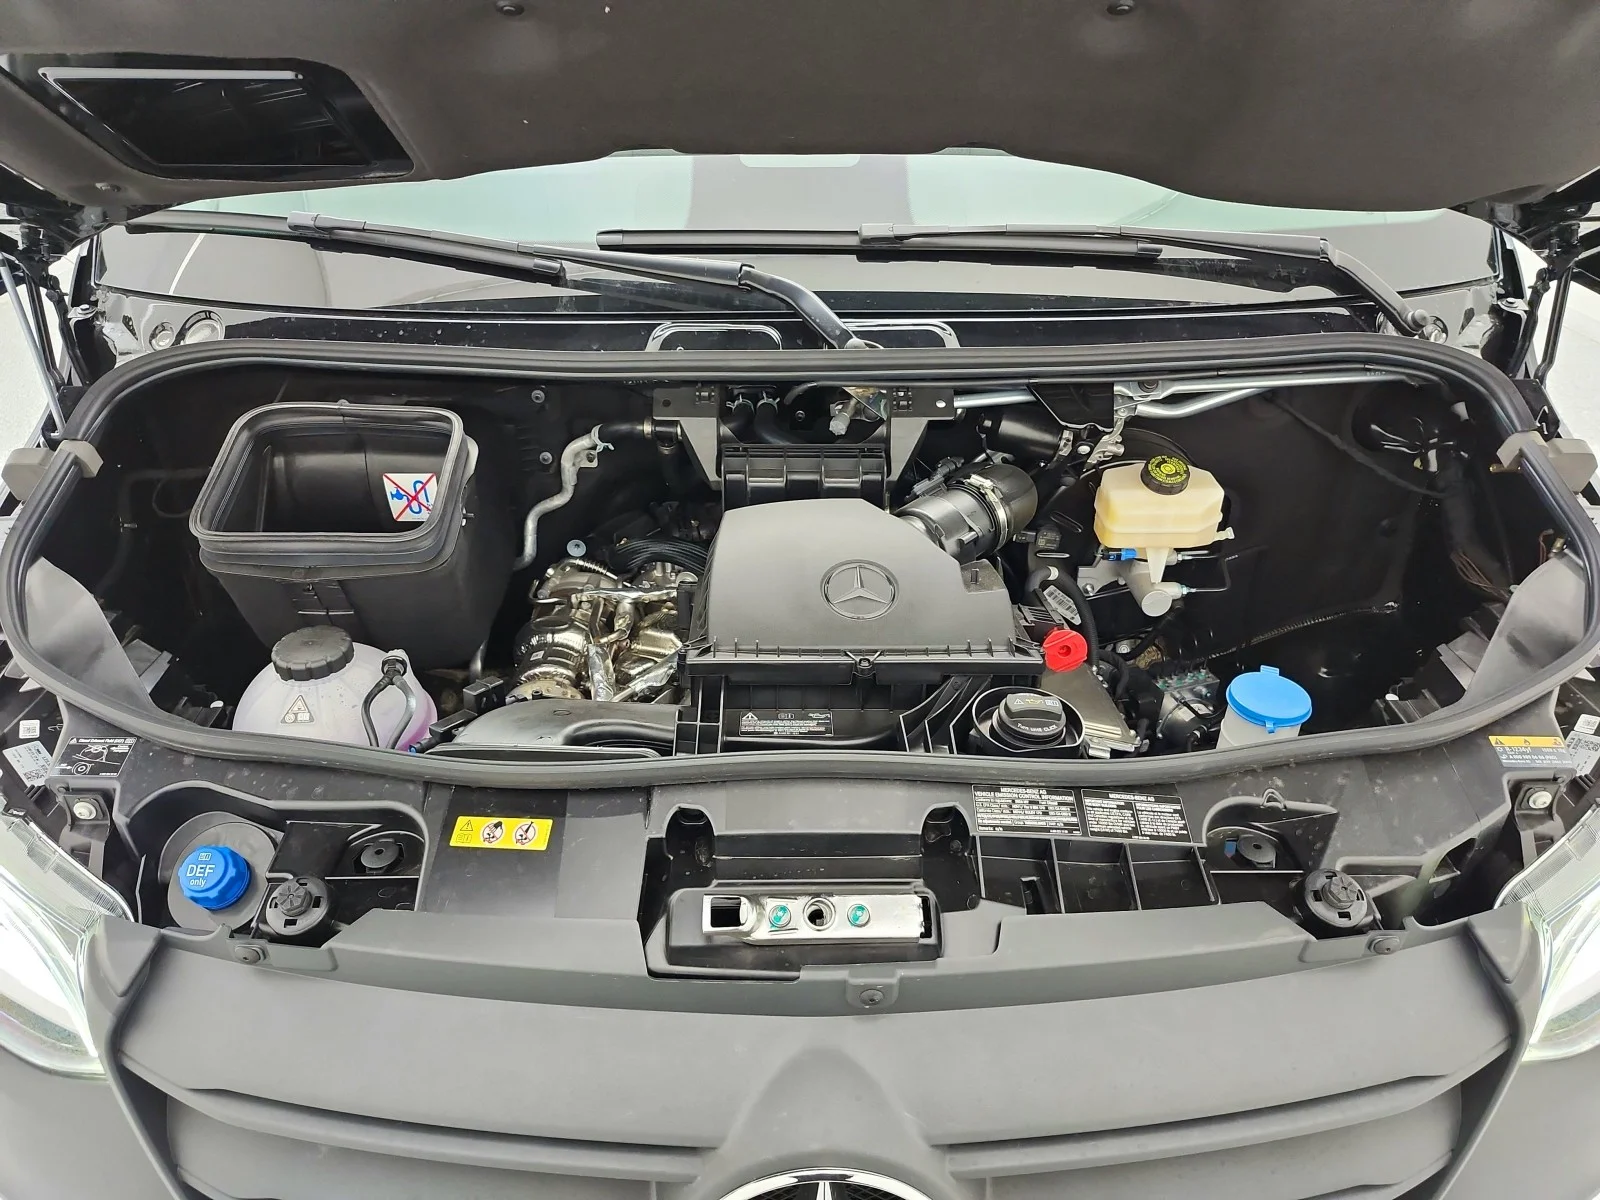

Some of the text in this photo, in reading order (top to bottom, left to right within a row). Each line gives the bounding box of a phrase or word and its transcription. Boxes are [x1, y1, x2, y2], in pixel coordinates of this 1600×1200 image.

[1043, 724, 1058, 732] CLICK
[186, 864, 216, 877] DEF
[189, 877, 206, 888] only
